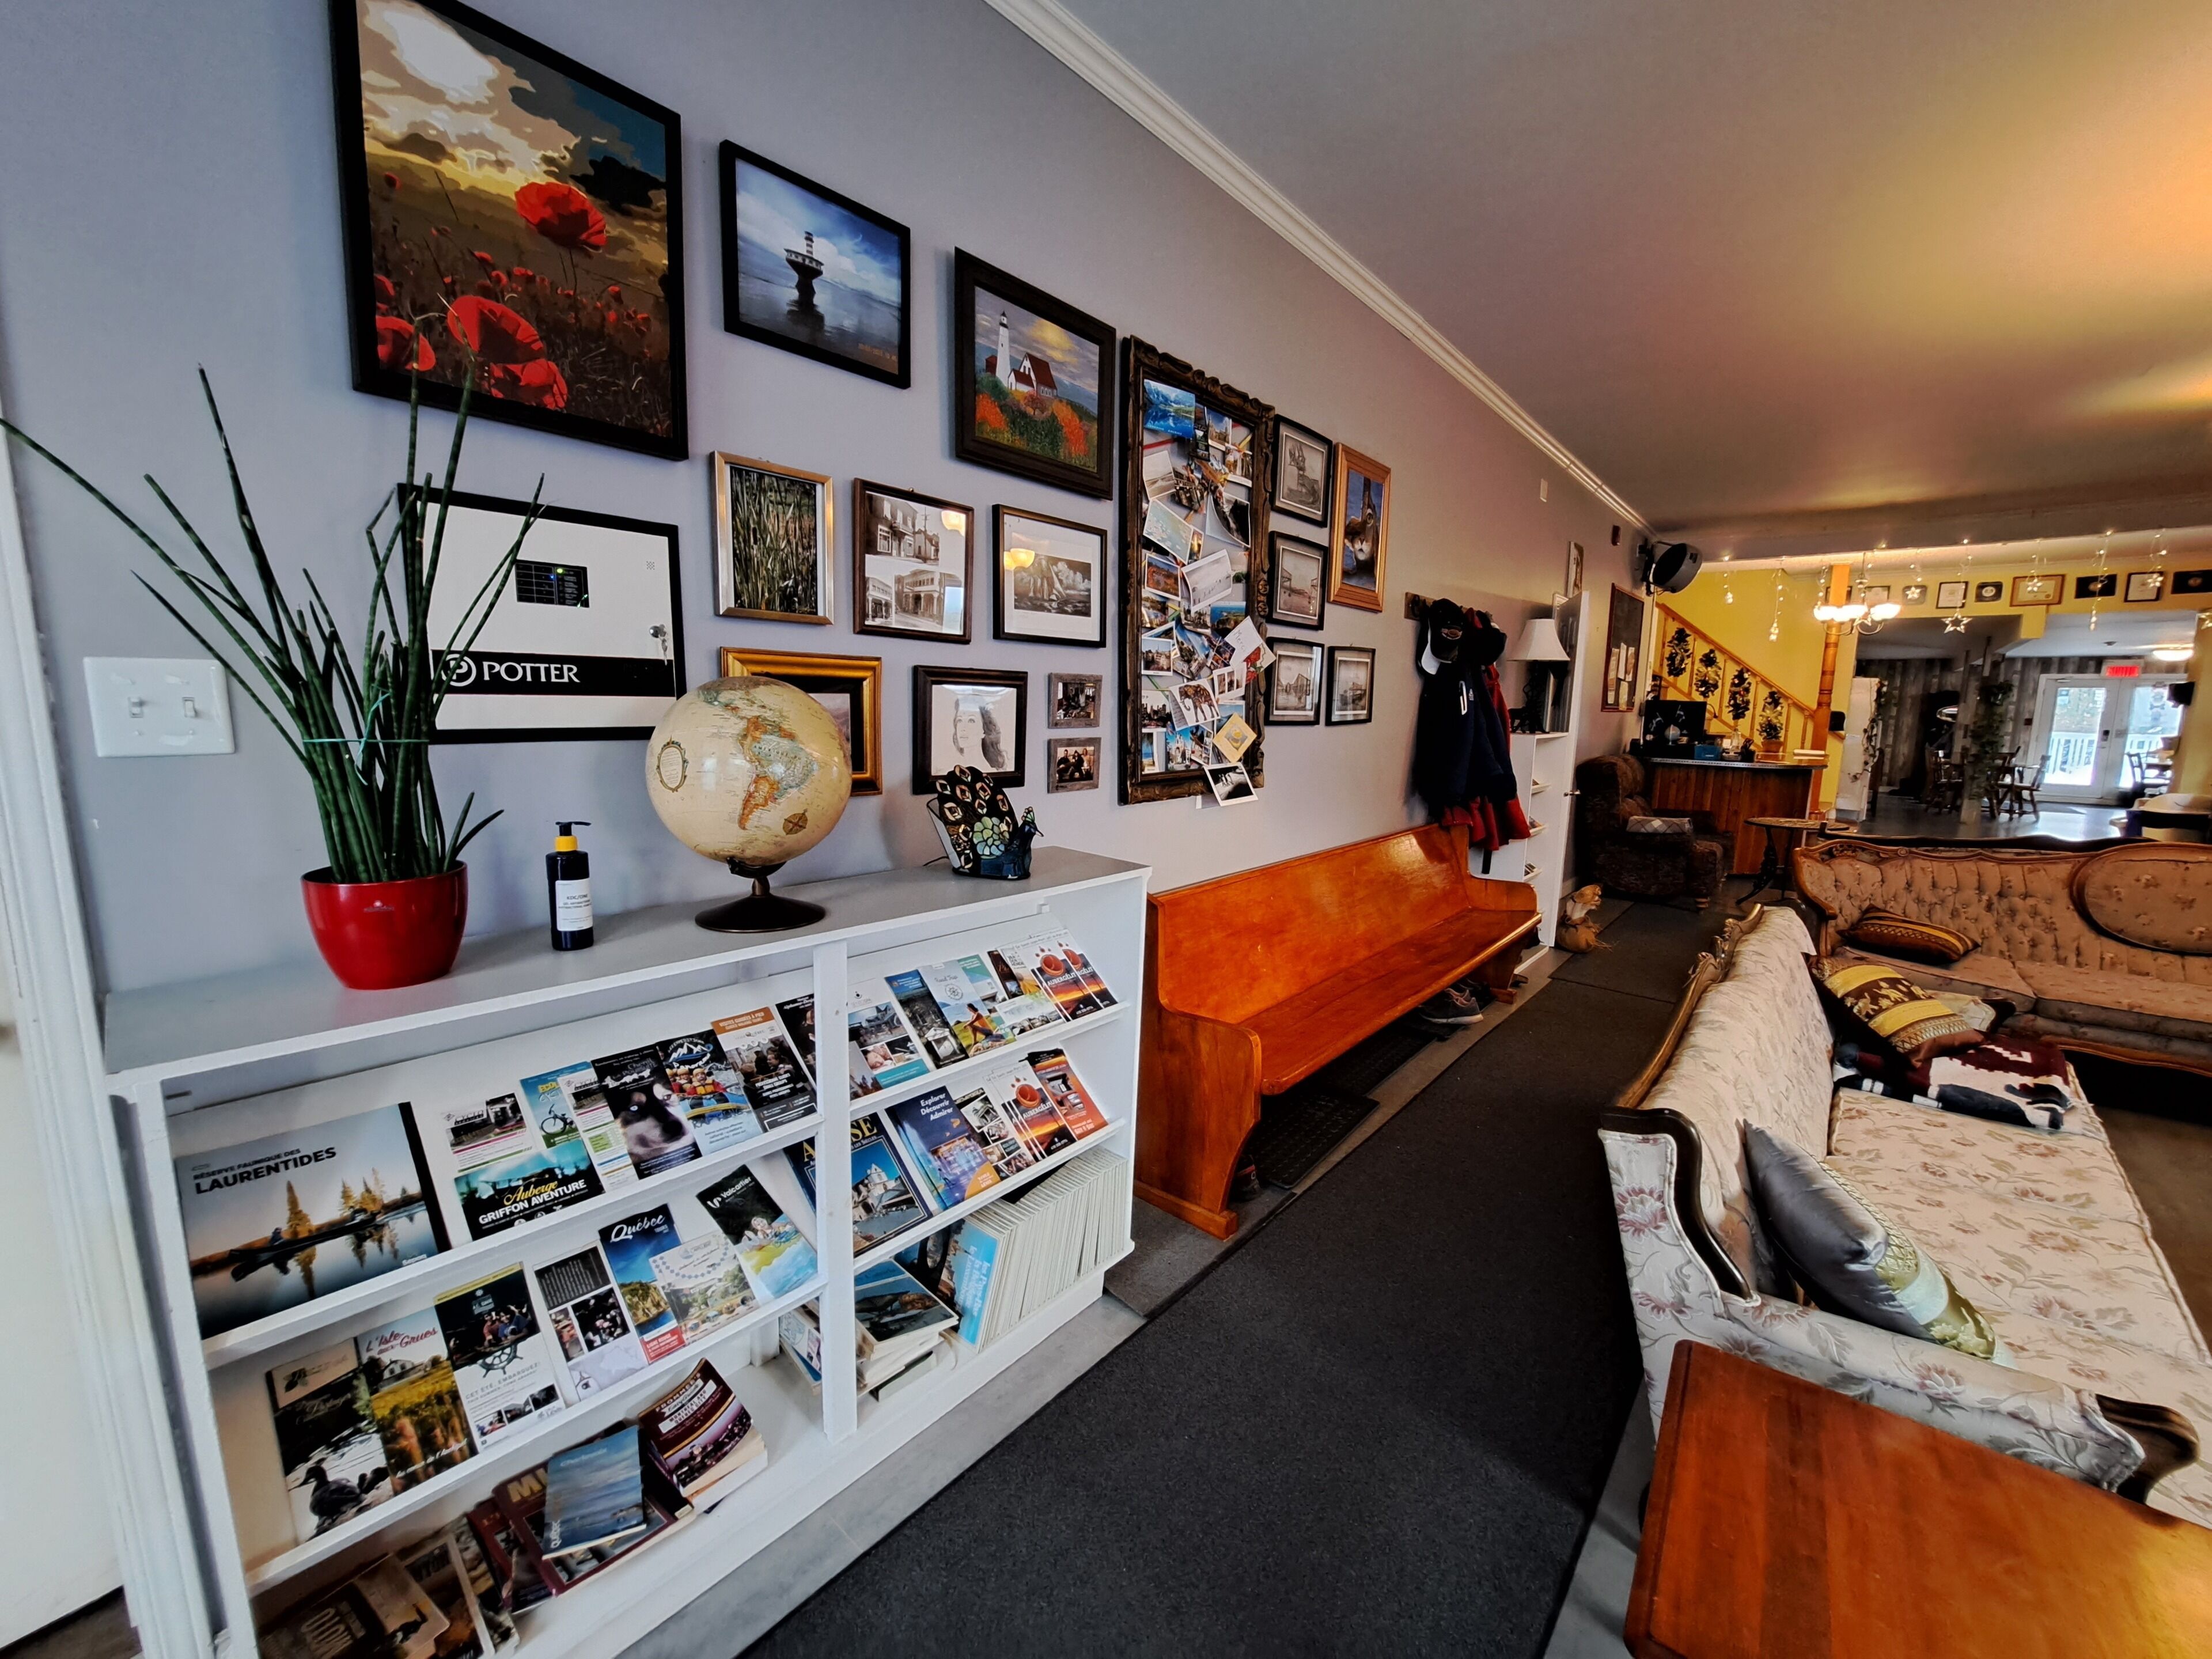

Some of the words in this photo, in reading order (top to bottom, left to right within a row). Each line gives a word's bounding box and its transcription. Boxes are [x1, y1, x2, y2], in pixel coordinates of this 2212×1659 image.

[482, 661, 581, 683] POTTER
[920, 1092, 946, 1107] Explorer
[921, 1099, 950, 1116] Découvrir
[930, 1107, 953, 1121] Admirer
[283, 1148, 301, 1157] DES
[195, 1146, 337, 1194] LAURENTIDES
[503, 1180, 558, 1206] Auberge
[719, 1176, 752, 1198] Valcartier
[479, 1200, 529, 1225] GRIFFON
[531, 1179, 587, 1206] AVENTURE
[609, 1214, 666, 1243] Québec
[465, 1390, 479, 1400] CET
